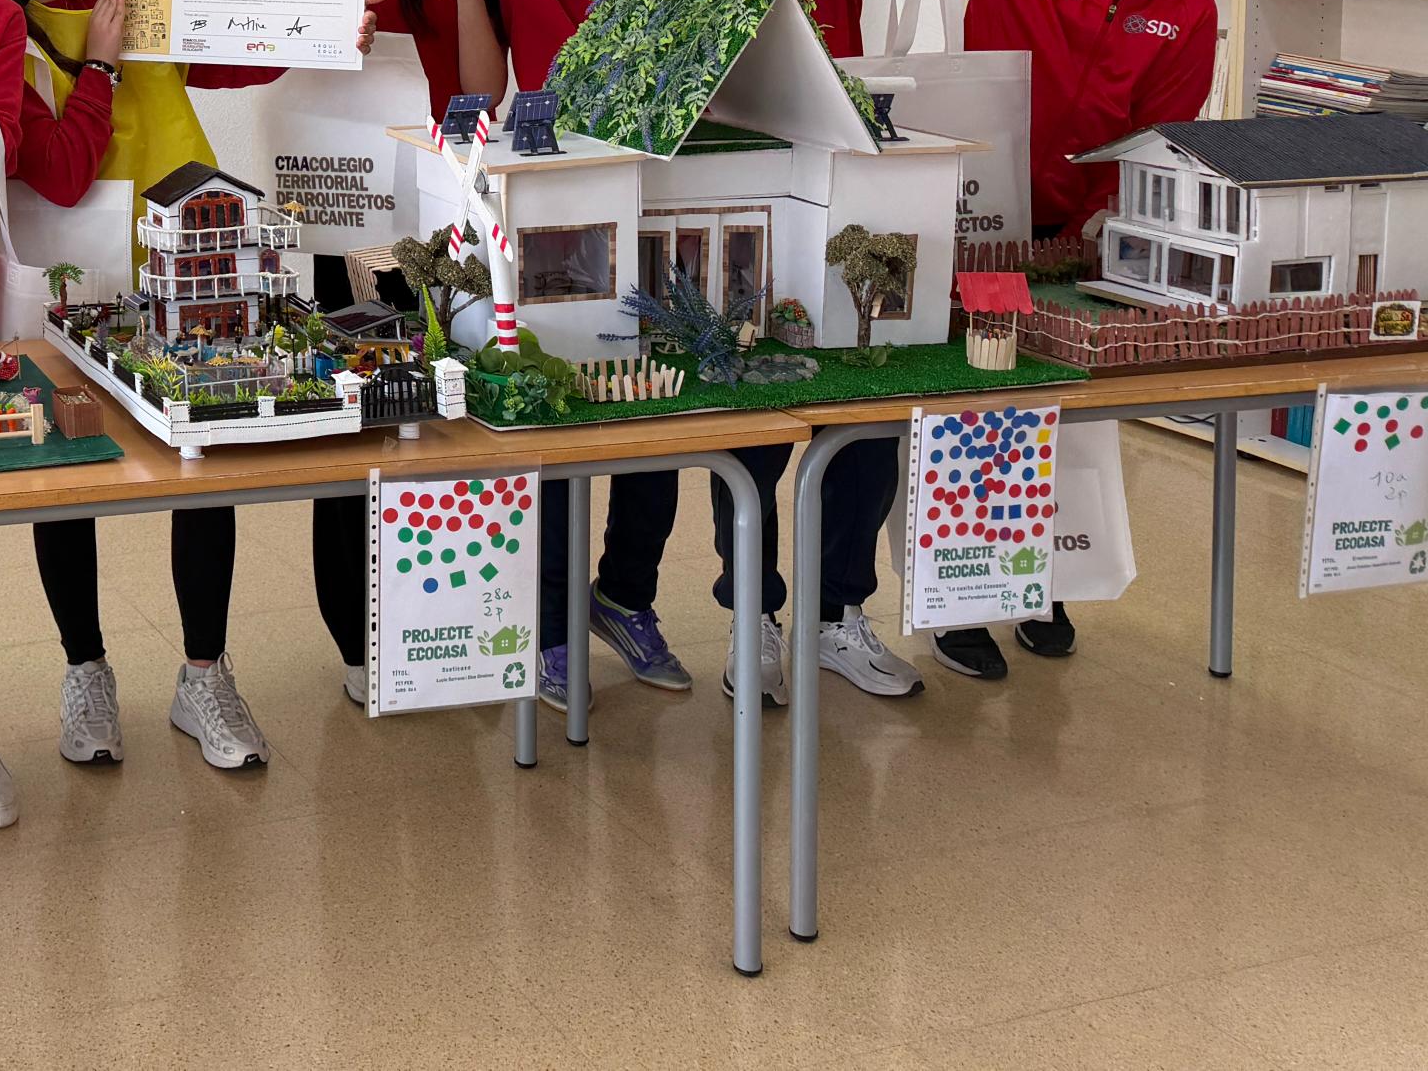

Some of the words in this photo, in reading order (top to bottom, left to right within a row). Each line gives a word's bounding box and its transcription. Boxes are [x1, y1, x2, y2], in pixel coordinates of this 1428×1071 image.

[1145, 19, 1180, 40] SDS
[276, 174, 369, 191] TERRITORIAL
[276, 190, 396, 211] DEARQUITECTOS
[1332, 520, 1393, 535] PROJECTE
[1335, 536, 1385, 551] ECOCASA
[934, 546, 996, 562] PROJECTE
[938, 563, 991, 580] ECOCASA
[402, 625, 474, 643] PROJECTE
[407, 644, 468, 662] ECOCASA
